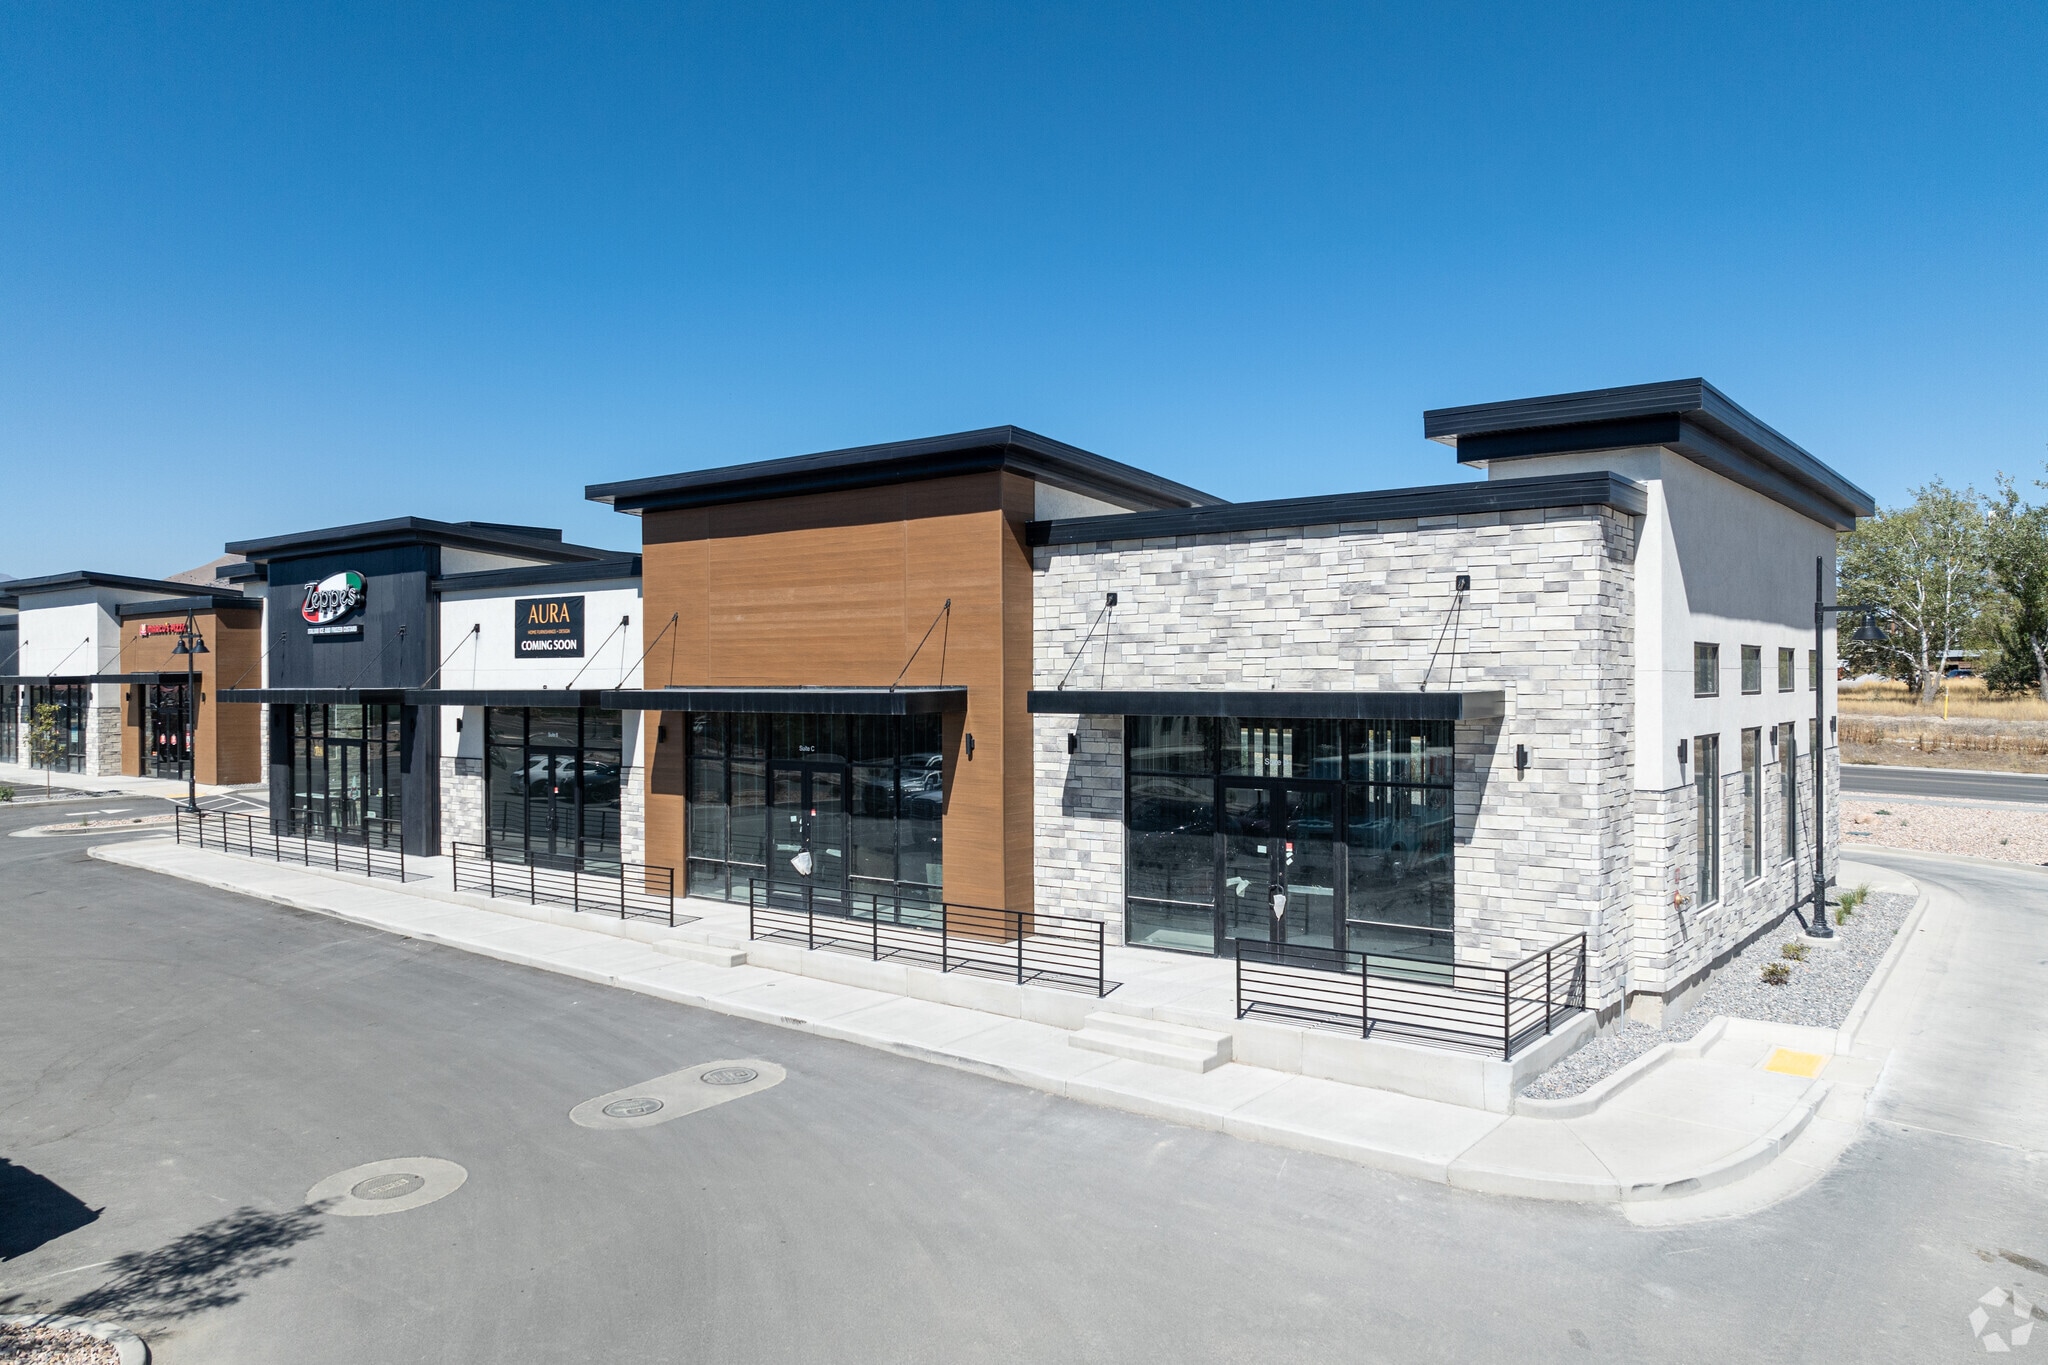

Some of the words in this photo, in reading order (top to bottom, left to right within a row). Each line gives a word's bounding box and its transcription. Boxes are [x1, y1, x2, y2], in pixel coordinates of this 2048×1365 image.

[304, 582, 356, 613] Zeppe's
[528, 602, 570, 624] AURA
[521, 640, 553, 651] COMING
[553, 639, 577, 650] SOON
